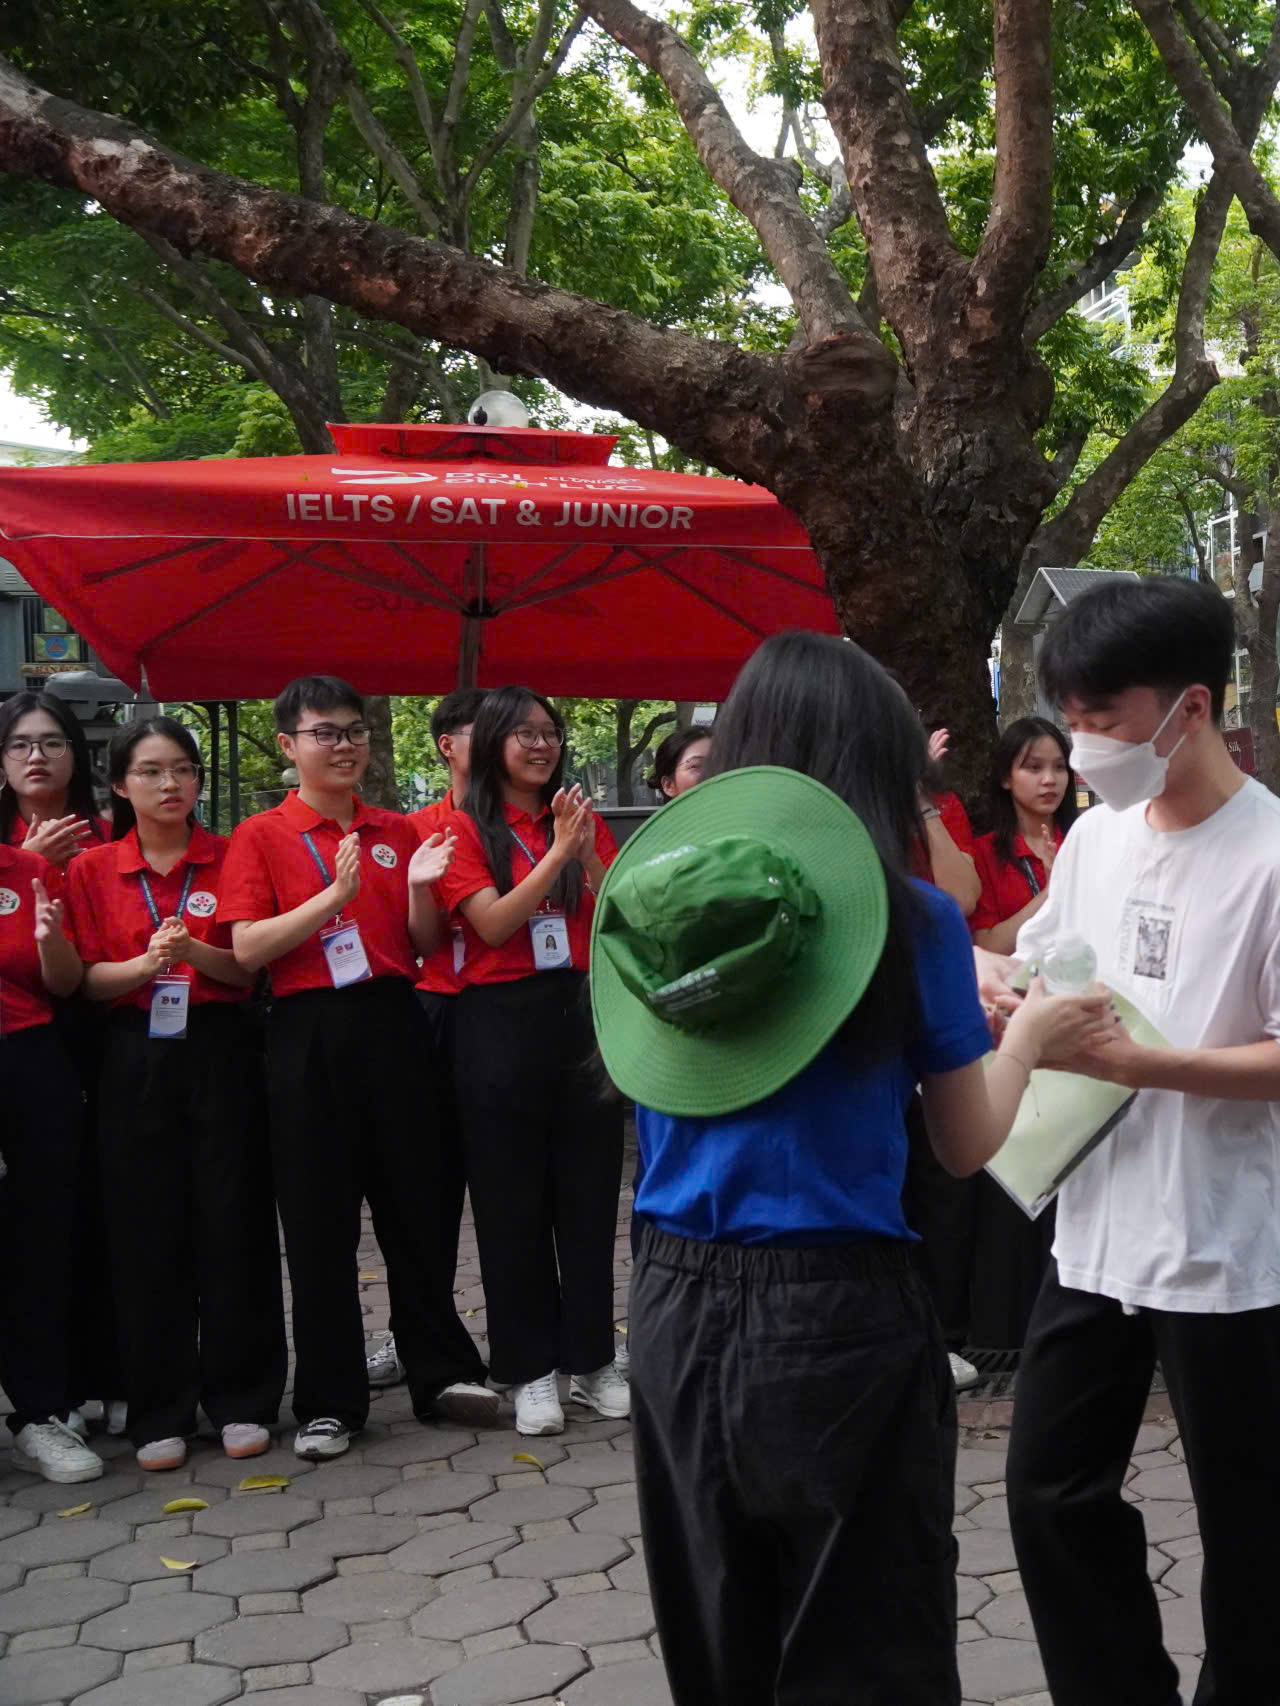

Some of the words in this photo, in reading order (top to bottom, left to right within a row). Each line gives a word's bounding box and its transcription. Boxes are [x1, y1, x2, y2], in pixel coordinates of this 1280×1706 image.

[286, 493, 395, 523] IELTS
[430, 496, 507, 526] SAT
[515, 500, 543, 527] &
[553, 501, 695, 530] JUNIOR
